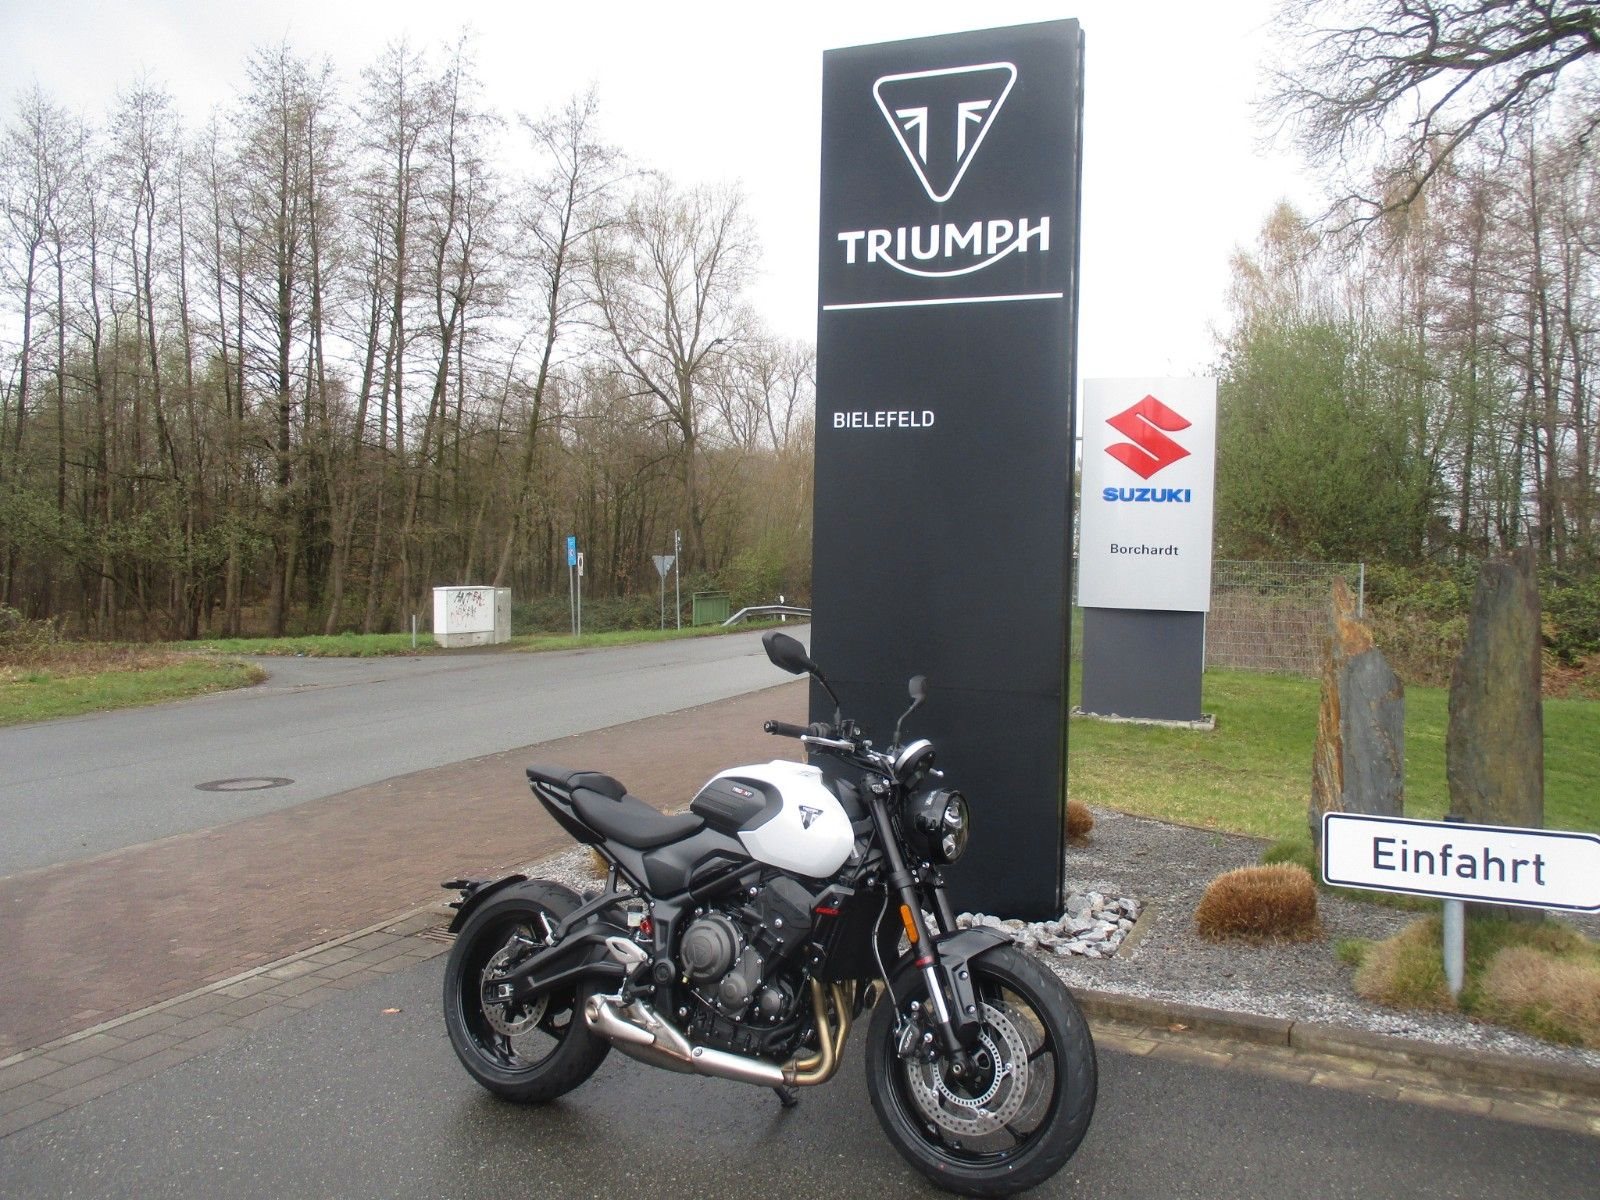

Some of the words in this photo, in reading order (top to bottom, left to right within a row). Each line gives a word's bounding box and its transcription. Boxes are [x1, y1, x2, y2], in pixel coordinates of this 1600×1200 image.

[837, 216, 1051, 278] TRIUMPH
[833, 410, 935, 428] BIELEFELD
[1102, 487, 1191, 503] SUZUKI
[1110, 543, 1179, 556] Borchardt
[1373, 836, 1546, 886] Einfahrt
